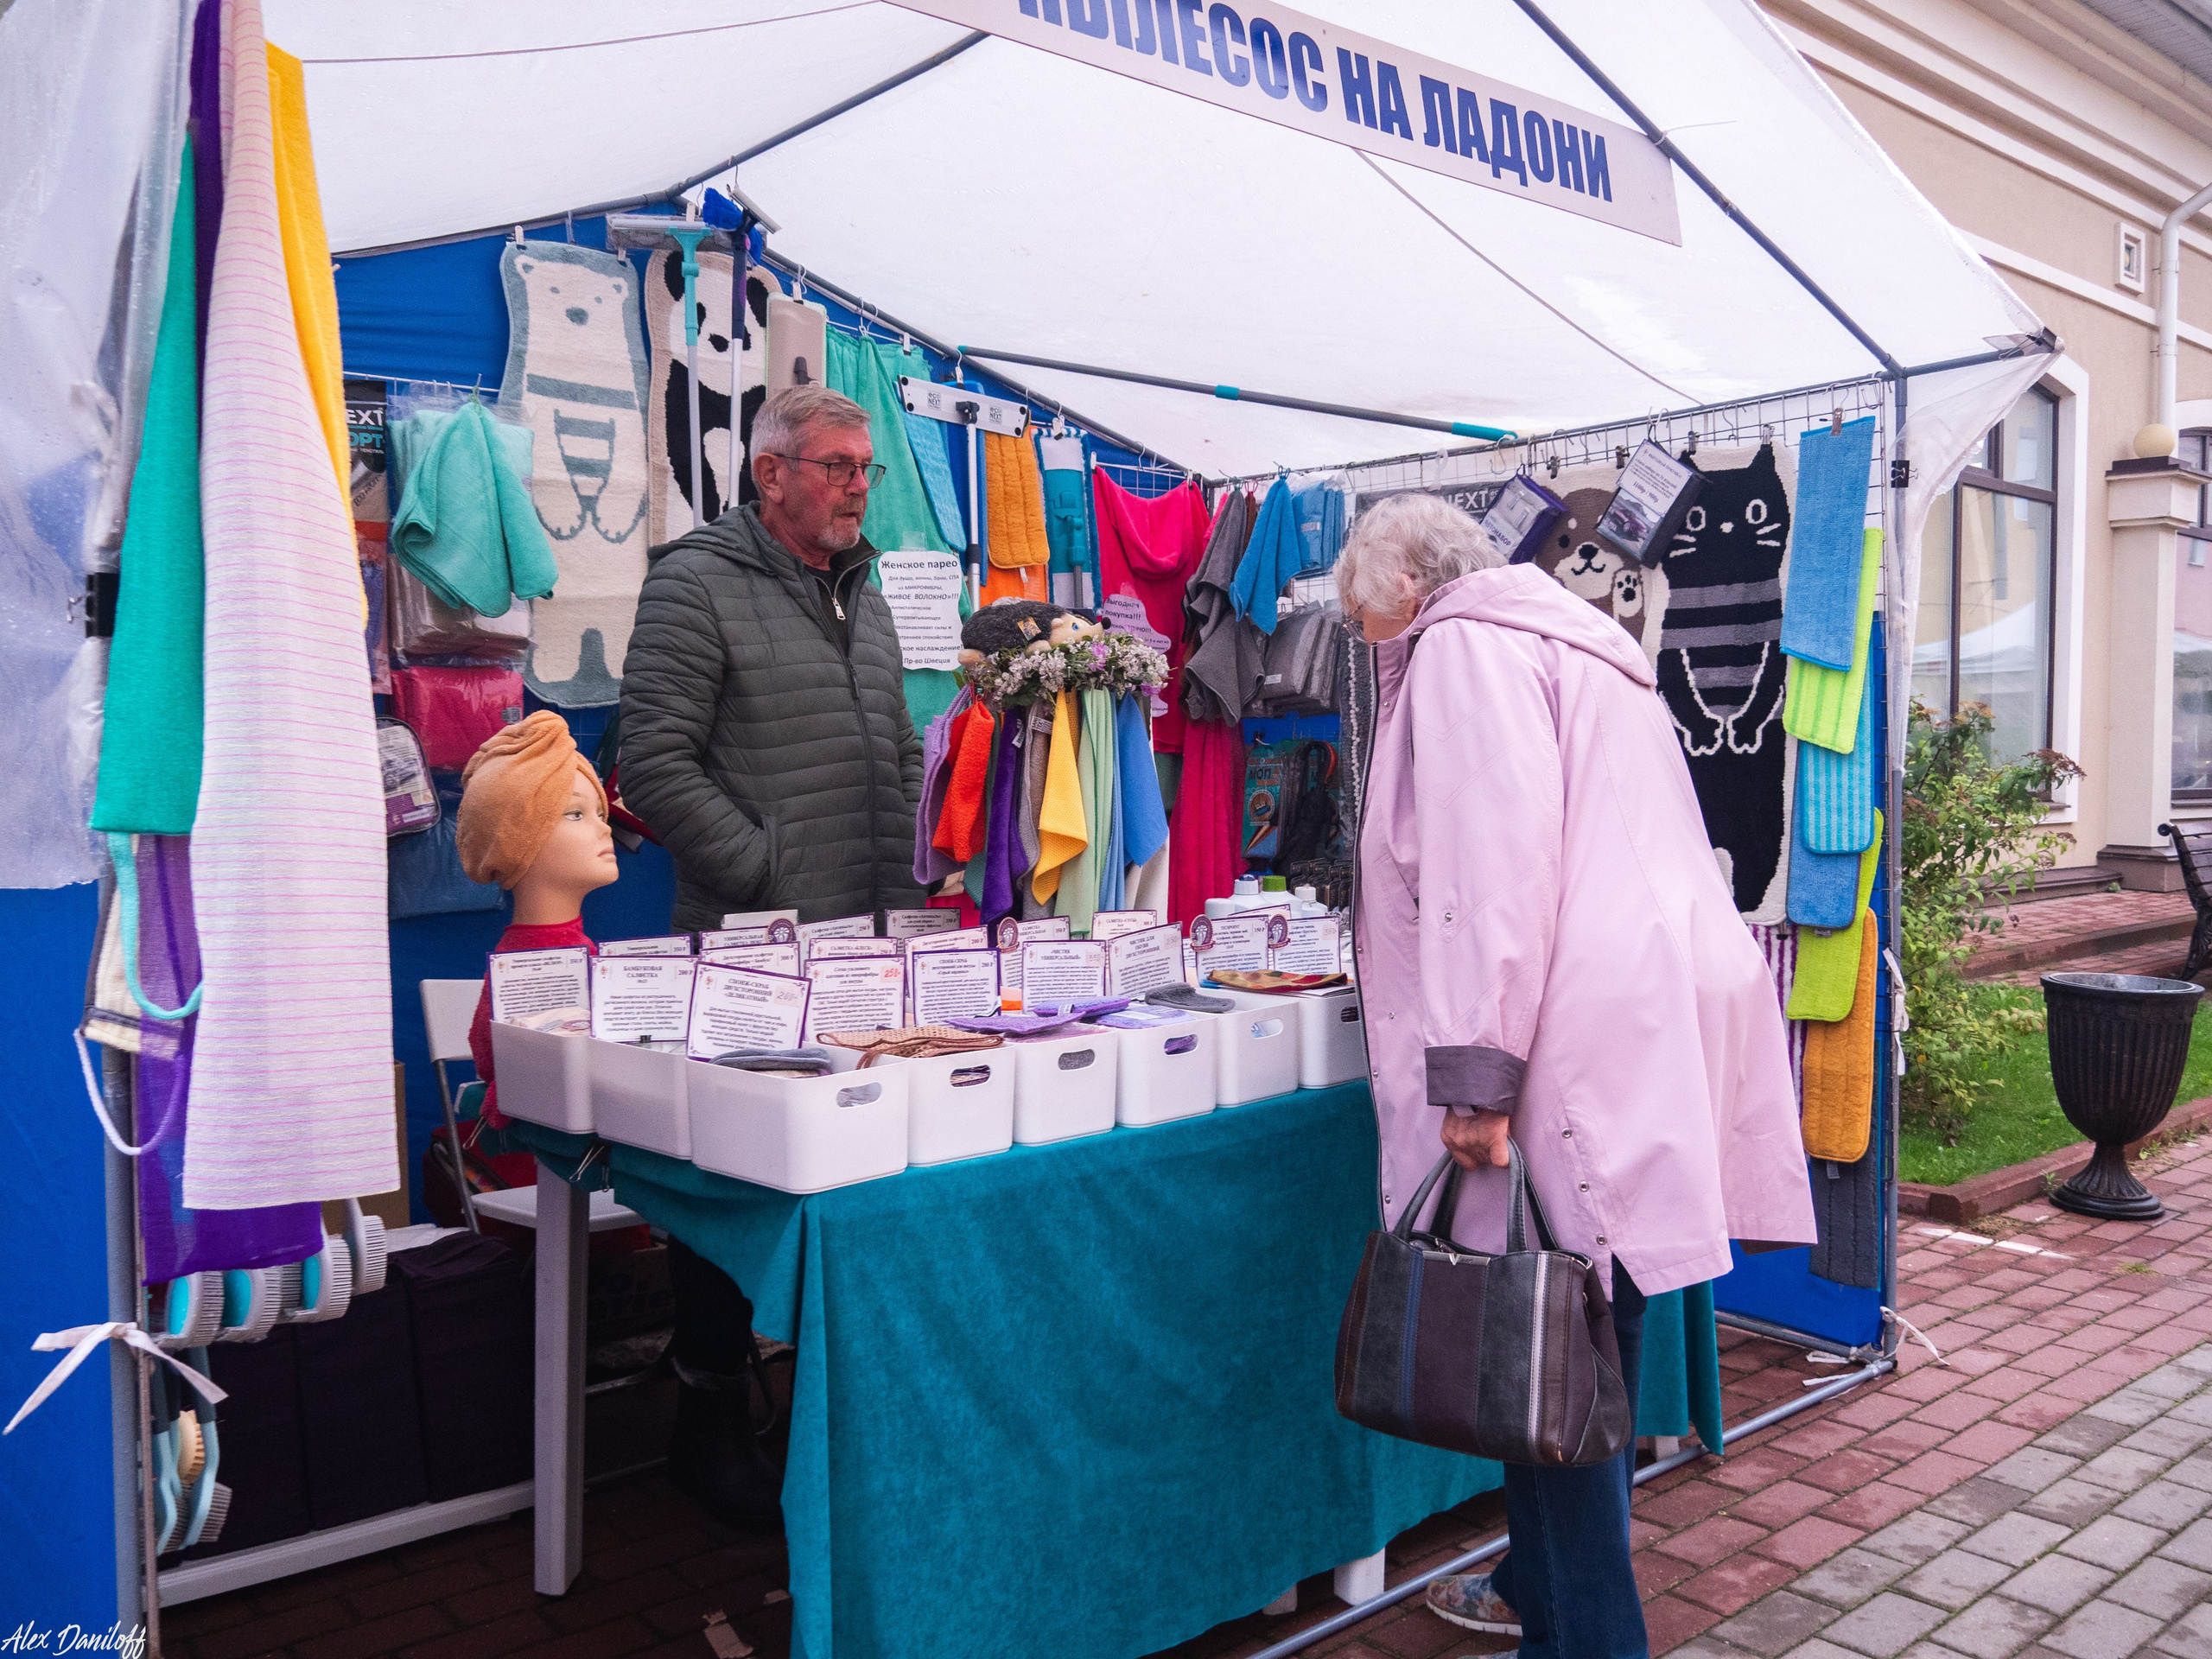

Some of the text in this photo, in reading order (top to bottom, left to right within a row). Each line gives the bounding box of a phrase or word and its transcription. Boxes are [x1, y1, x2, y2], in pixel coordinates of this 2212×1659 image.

[1336, 46, 1414, 141] НА
[1423, 74, 1613, 203] ЛАДОНИ
[346, 409, 384, 426] EXT
[1485, 519, 1511, 546] АВТОНАБОР
[928, 561, 957, 569] парео
[1106, 610, 1141, 620] покупка!!!
